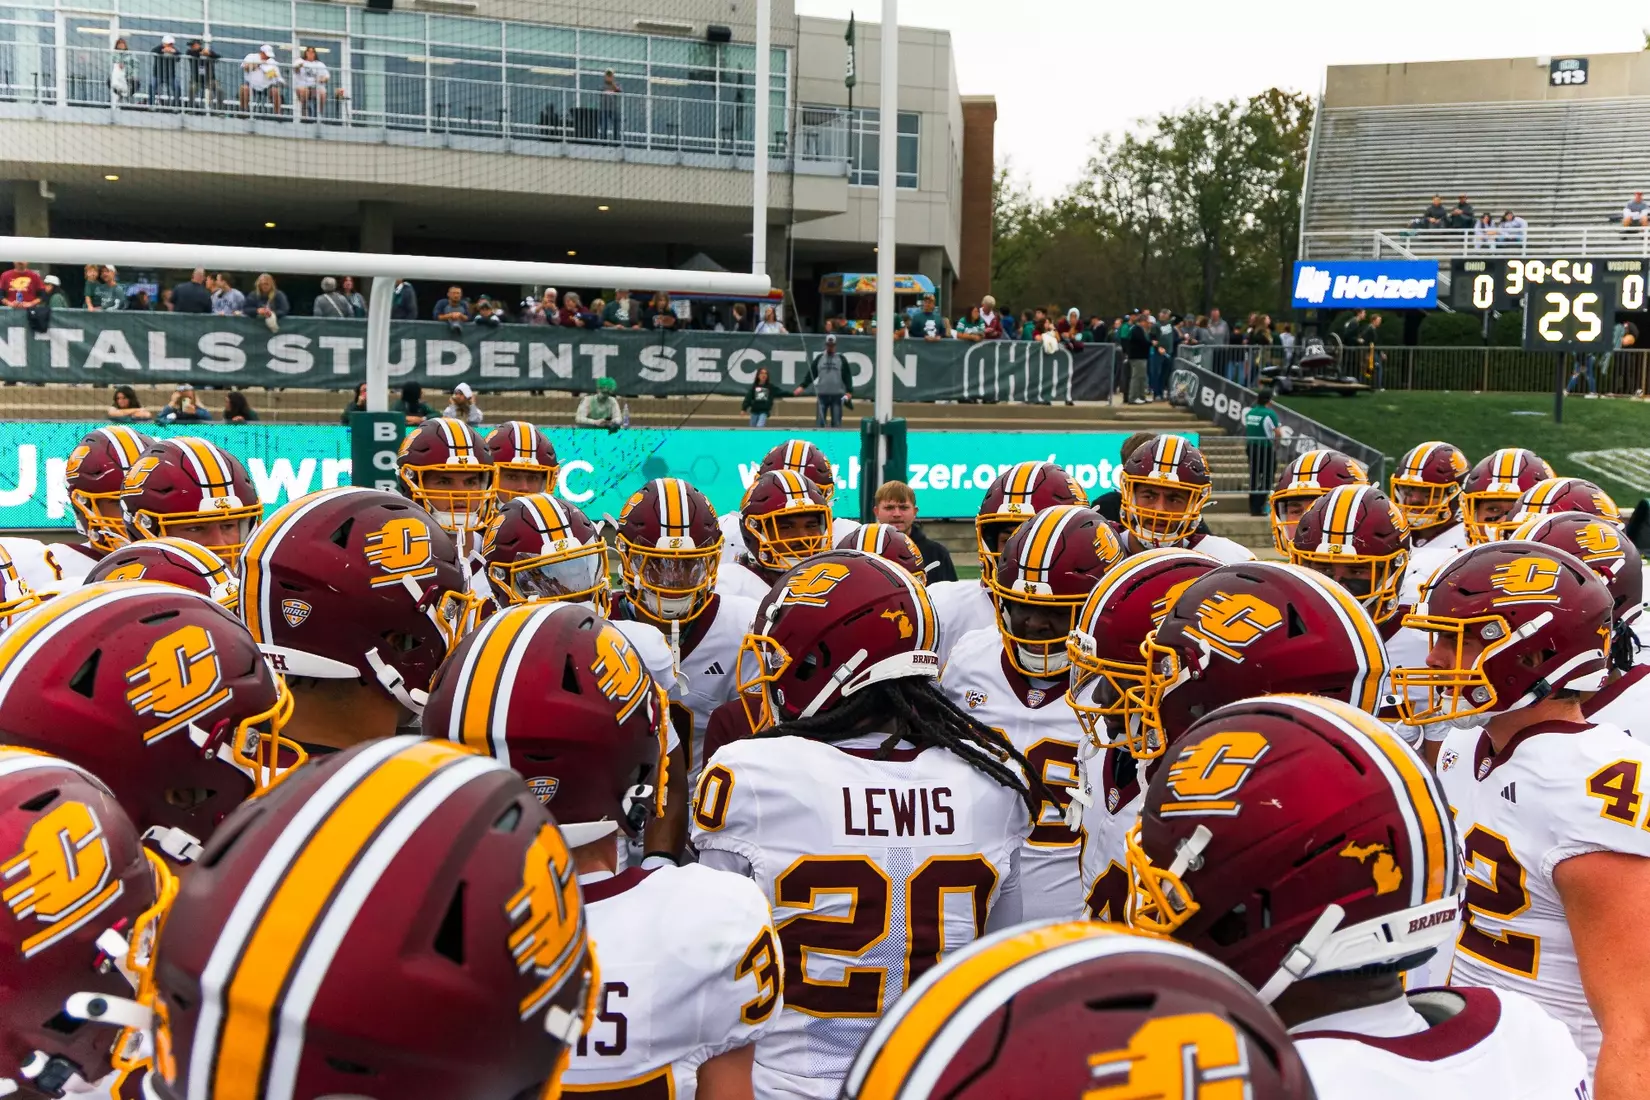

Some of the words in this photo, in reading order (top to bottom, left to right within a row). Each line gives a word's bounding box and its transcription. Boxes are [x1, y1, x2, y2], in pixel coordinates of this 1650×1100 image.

[1552, 70, 1586, 84] 113
[1332, 275, 1436, 300] Holzer
[1607, 261, 1642, 272] VISITOR
[1473, 274, 1494, 309] 0
[1621, 274, 1644, 309] 0
[1538, 292, 1602, 342] 25
[637, 345, 918, 388] SECTON
[693, 762, 736, 833] 0
[842, 786, 955, 837] LEWIS
[1585, 757, 1650, 832] 4
[1455, 822, 1542, 981] 2
[773, 853, 1000, 1019] 20
